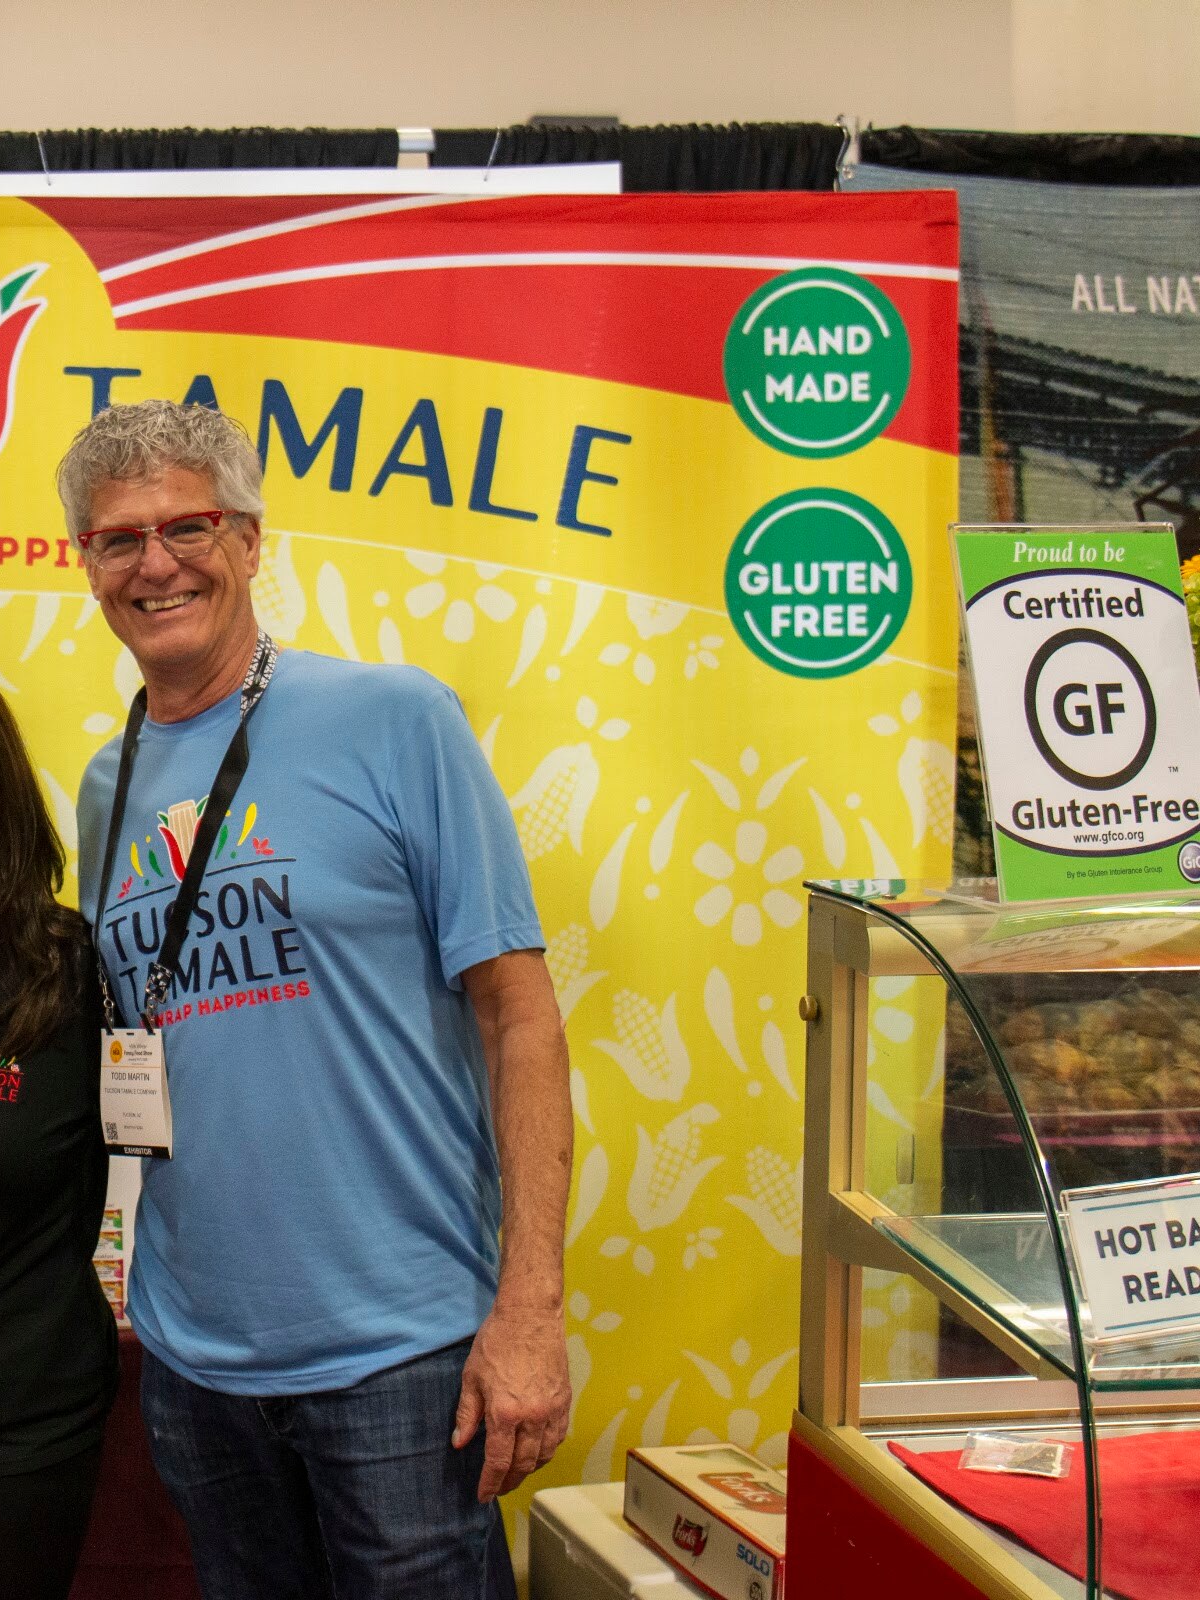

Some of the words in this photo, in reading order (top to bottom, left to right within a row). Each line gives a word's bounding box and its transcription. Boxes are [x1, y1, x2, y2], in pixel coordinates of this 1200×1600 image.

[1072, 274, 1137, 313] ALL
[764, 326, 872, 357] HAND
[764, 372, 871, 403] MADE
[1013, 541, 1073, 564] Proud
[1078, 543, 1098, 563] to
[1104, 541, 1126, 563] be
[738, 560, 898, 596] GLUTEN
[1003, 588, 1145, 620] Certified
[770, 604, 869, 639] FREE
[1052, 682, 1126, 736] GF
[1011, 795, 1200, 831] Gluten-Free
[1073, 830, 1145, 844] www.gfco.org
[1066, 870, 1075, 879] By
[1077, 869, 1087, 878] the
[1087, 869, 1109, 879] Gluten
[1110, 866, 1143, 876] Intolerance
[1143, 865, 1163, 874] Group
[198, 980, 312, 1017] HAPPINESS
[111, 1071, 127, 1081] TODD
[127, 1072, 150, 1082] MARTIN
[123, 1146, 153, 1156] EXHIBITOR
[1094, 1222, 1157, 1259] HOT
[1122, 1265, 1200, 1304] READ
[736, 1543, 771, 1577] SOLO
